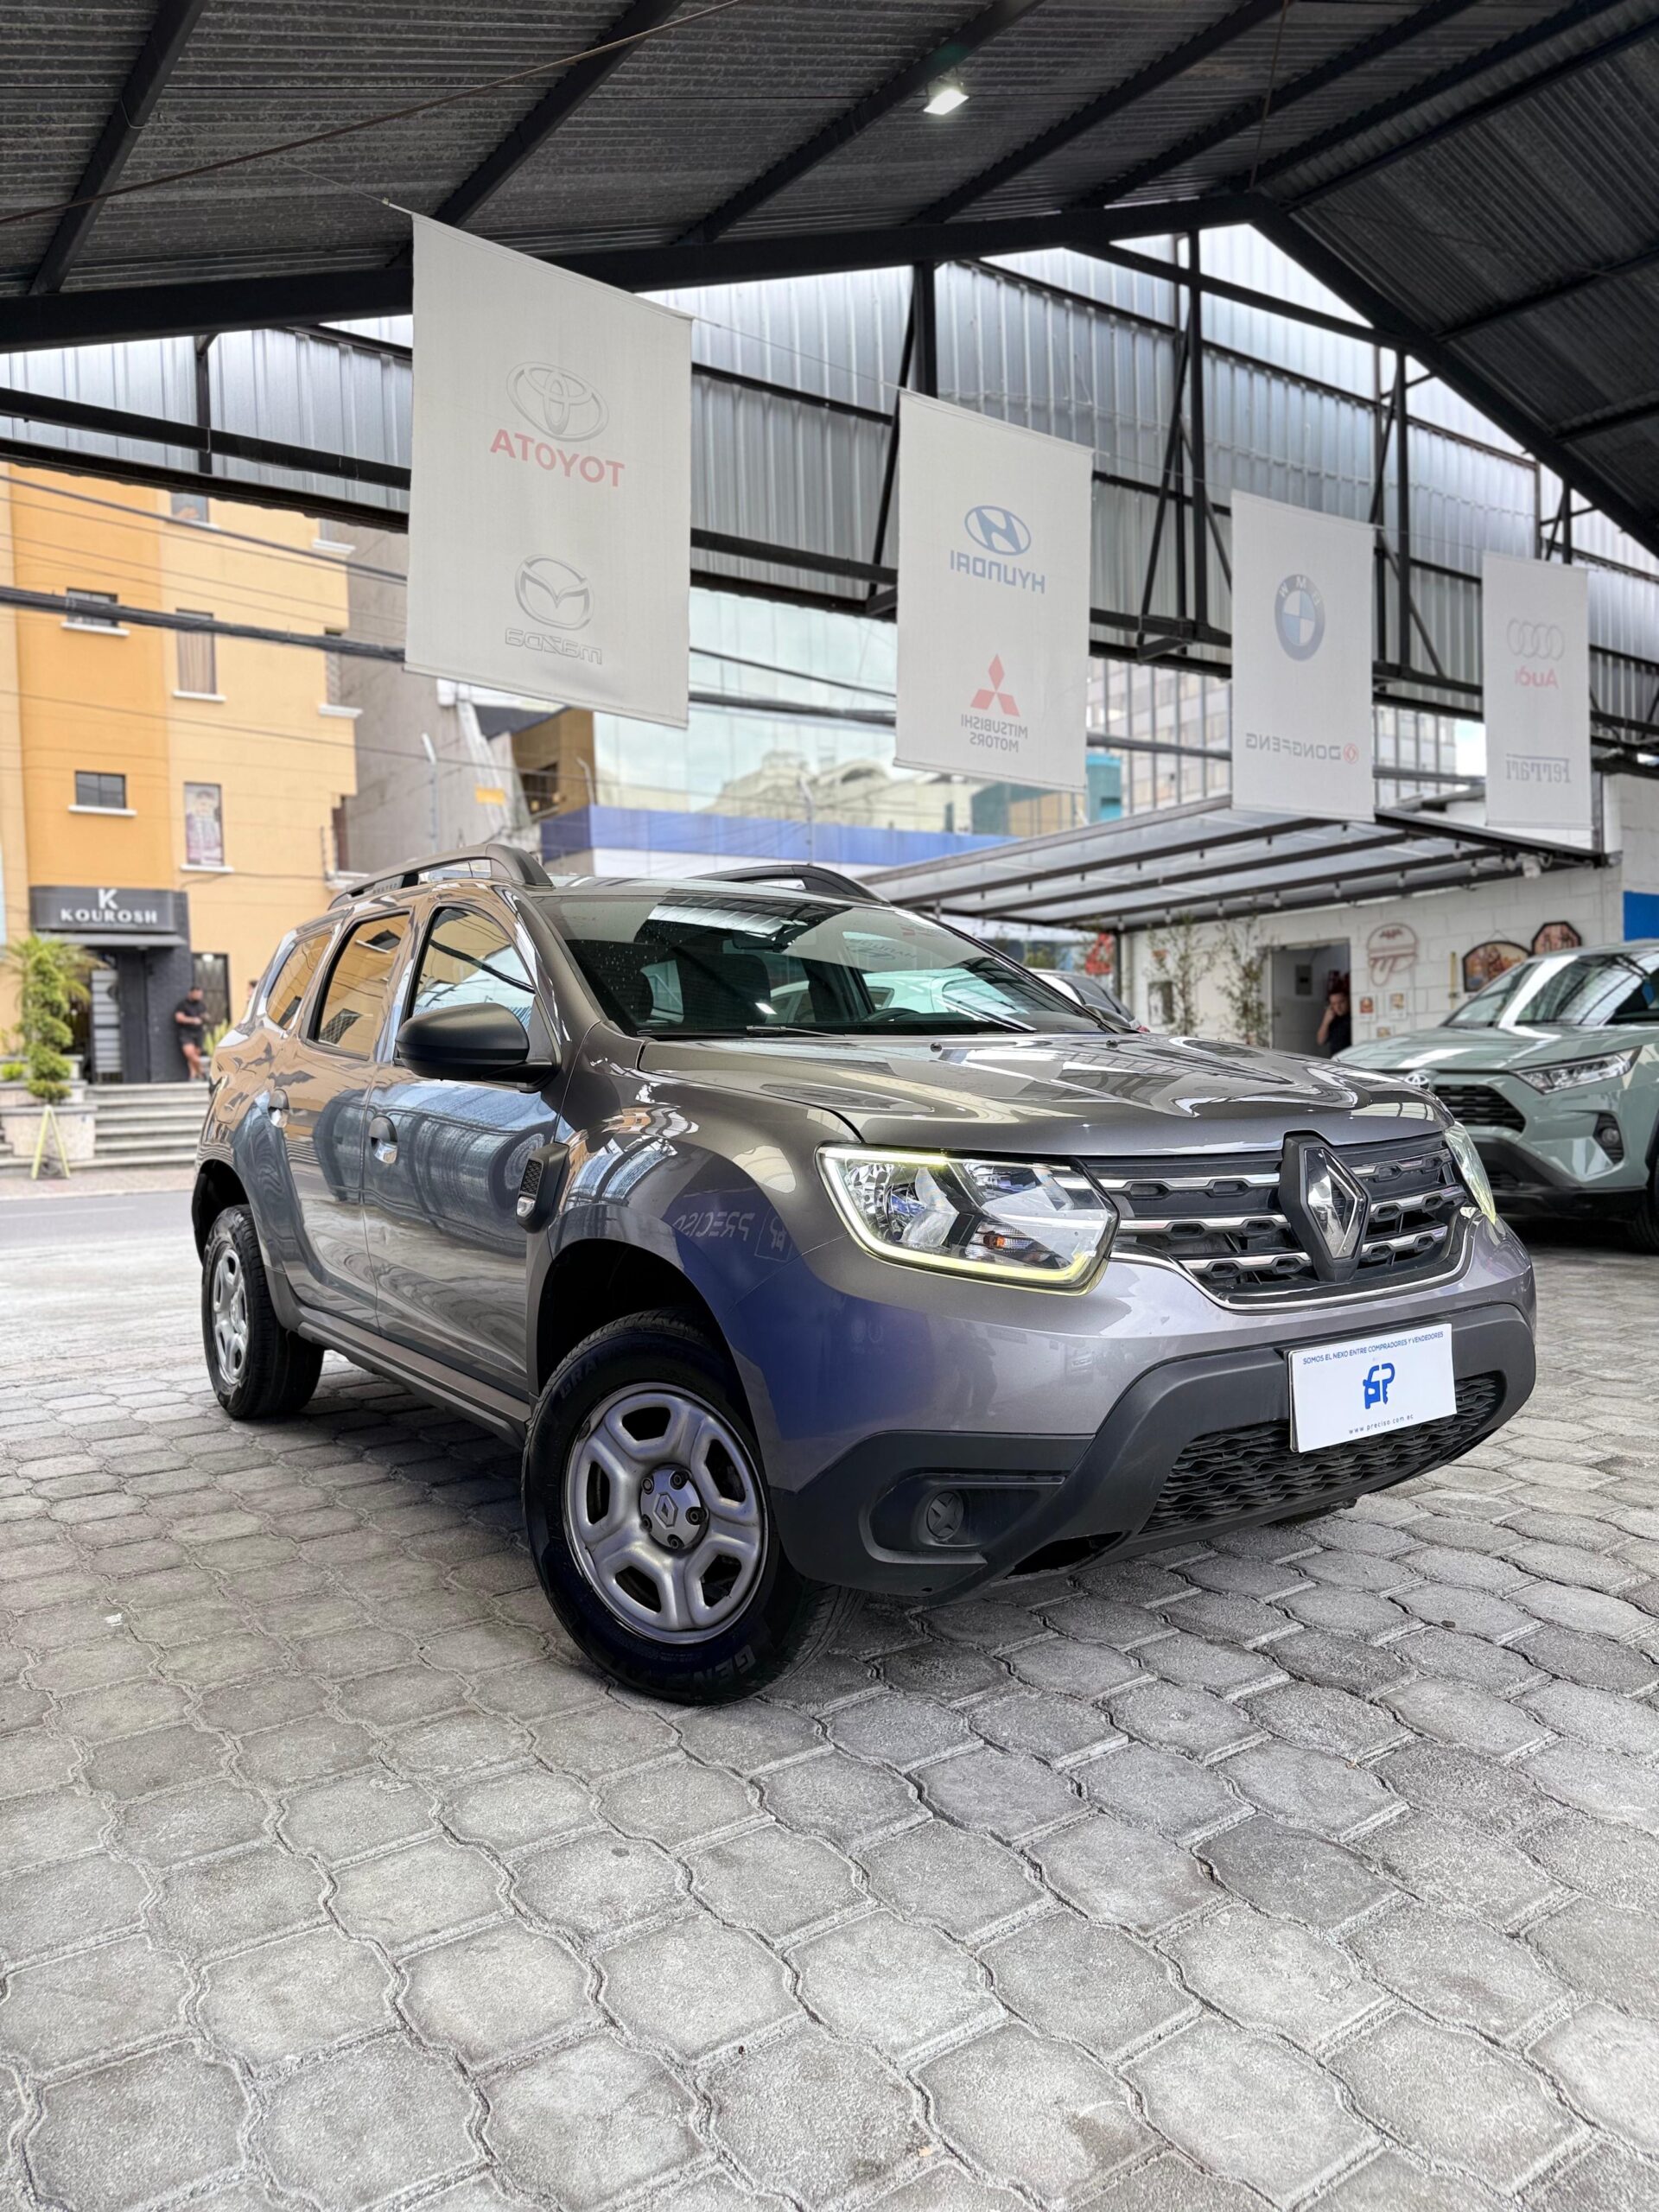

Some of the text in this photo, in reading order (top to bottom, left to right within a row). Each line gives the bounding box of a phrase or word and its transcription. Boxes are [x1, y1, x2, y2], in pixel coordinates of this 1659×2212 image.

[98, 887, 118, 910] K
[60, 908, 157, 925] KOUROSH
[1303, 1354, 1324, 1364] SOMOS
[1332, 1351, 1349, 1359] NEXO
[1349, 1346, 1367, 1357] ENTRE
[1368, 1338, 1408, 1353] COMPRADORES
[1412, 1332, 1444, 1344] VENDEDORES
